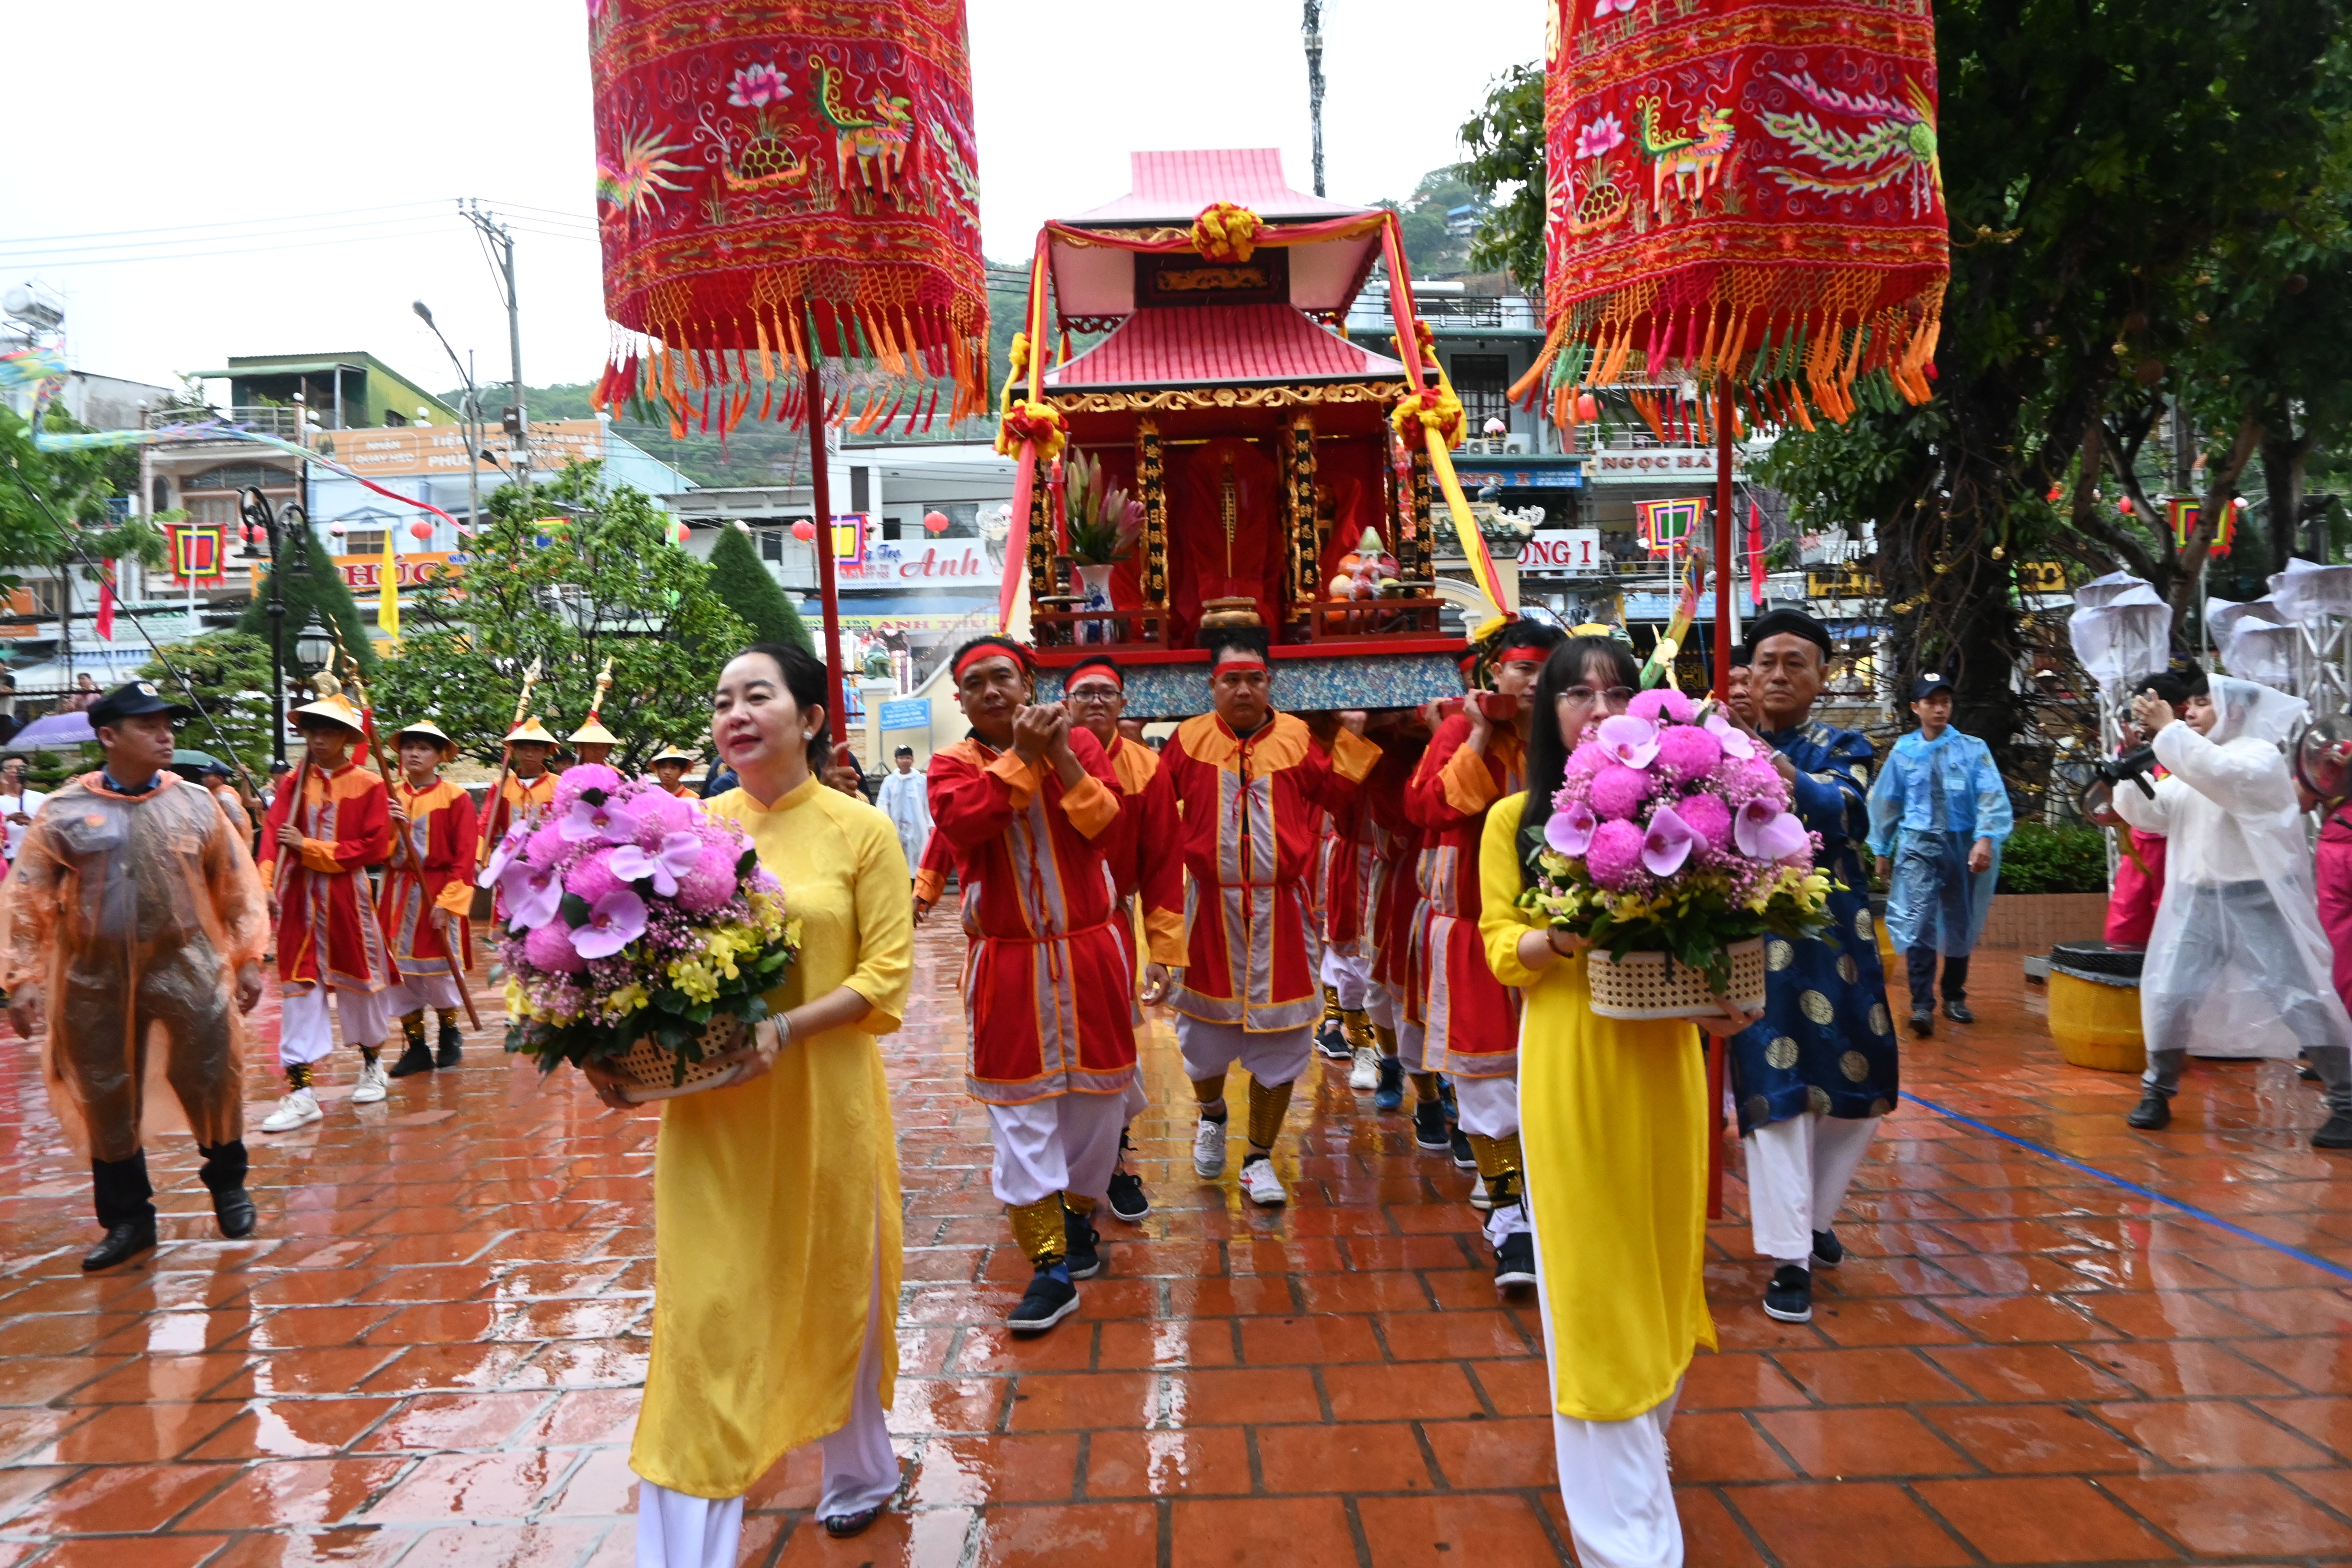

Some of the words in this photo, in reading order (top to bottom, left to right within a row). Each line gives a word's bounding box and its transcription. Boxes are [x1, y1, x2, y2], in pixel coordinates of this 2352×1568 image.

[1601, 456, 1670, 472] NGỌC
[1581, 541, 1591, 563] I
[899, 548, 981, 577] Anh
[879, 621, 930, 629] ANH
